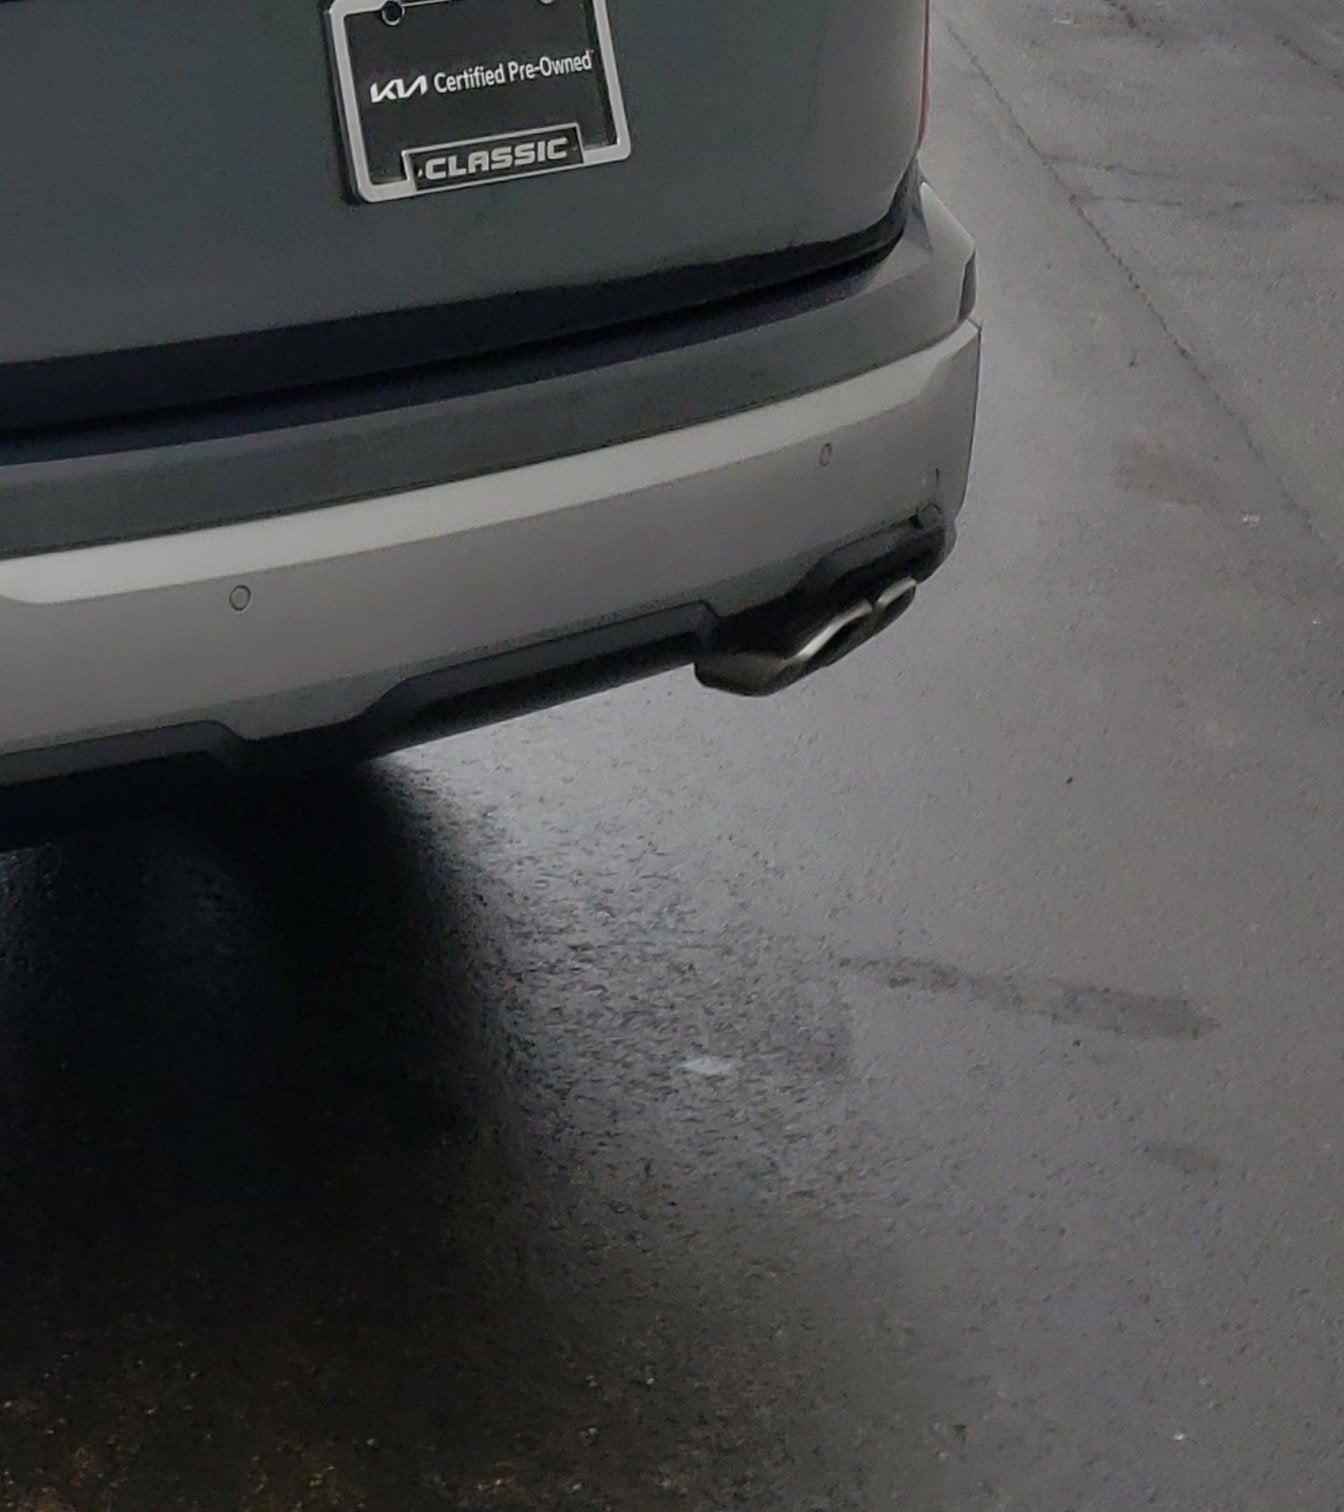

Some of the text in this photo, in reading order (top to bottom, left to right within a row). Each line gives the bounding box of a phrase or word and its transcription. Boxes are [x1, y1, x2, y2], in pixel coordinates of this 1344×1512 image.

[370, 49, 592, 103] KIA Certified Pre-Owned
[424, 137, 568, 180] CLASSIC
